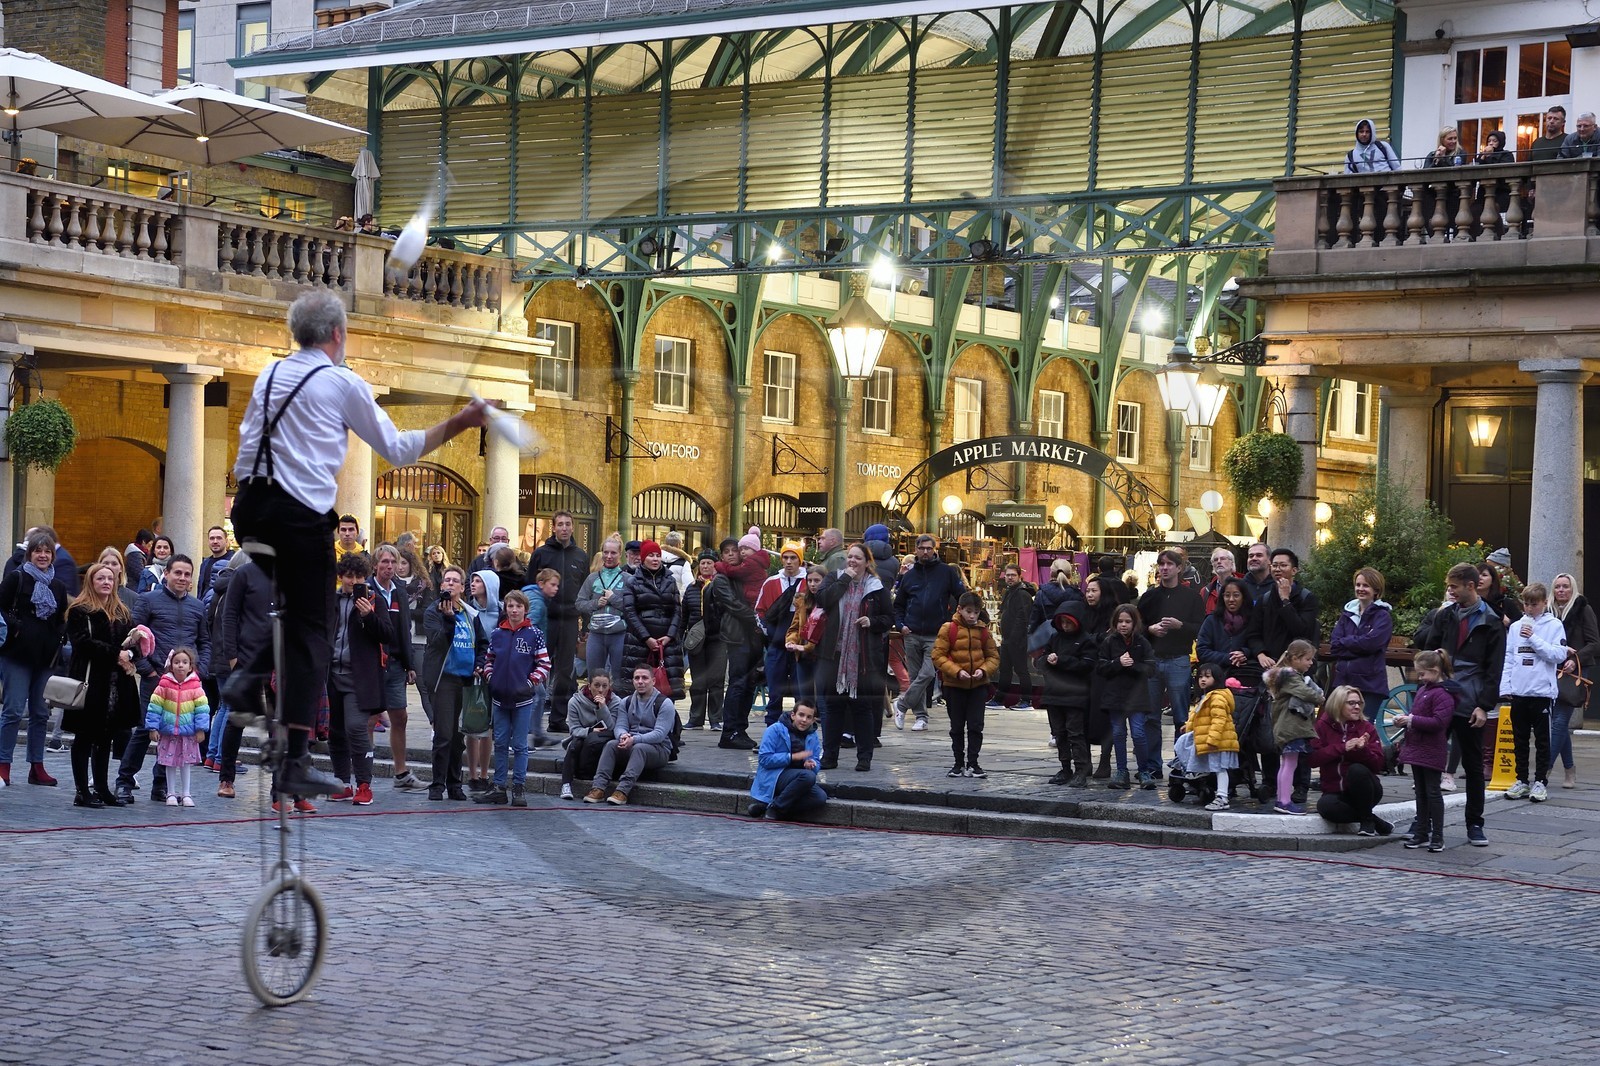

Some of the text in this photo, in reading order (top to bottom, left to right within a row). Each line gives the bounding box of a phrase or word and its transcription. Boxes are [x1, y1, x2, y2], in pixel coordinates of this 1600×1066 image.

[647, 441, 700, 459] TOM FORD
[953, 441, 1088, 466] APPLE MARKET
[856, 462, 902, 479] TOM FORD
[1042, 481, 1060, 494] Dior
[811, 506, 827, 514] FORD
[515, 637, 531, 654] LA
